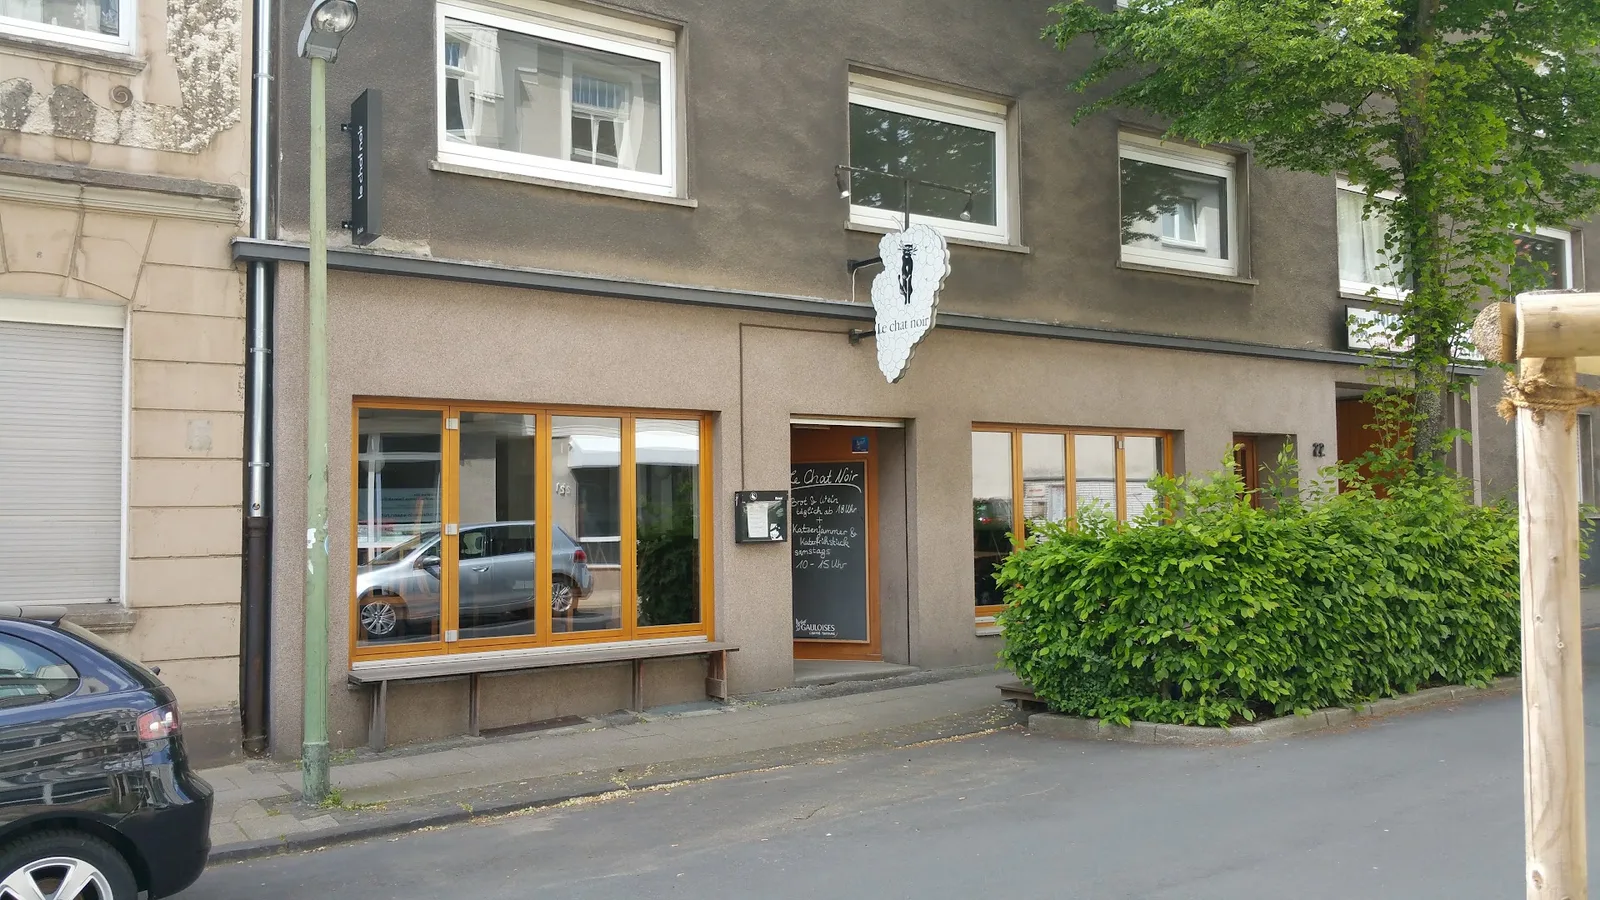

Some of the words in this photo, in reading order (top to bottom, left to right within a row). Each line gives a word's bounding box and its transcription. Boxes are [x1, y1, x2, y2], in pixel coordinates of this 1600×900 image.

[877, 323, 887, 334] le
[889, 320, 908, 332] chat
[910, 315, 929, 328] noir
[803, 468, 832, 484] Chat
[835, 467, 859, 483] Noir
[820, 494, 839, 505] Wein
[824, 506, 834, 515] ab
[792, 523, 848, 536] Katzenjammer
[794, 547, 831, 559] samstags
[796, 559, 809, 569] 10
[818, 559, 830, 569] 15
[831, 558, 848, 569] Uhr
[800, 623, 836, 631] GAULOISES
